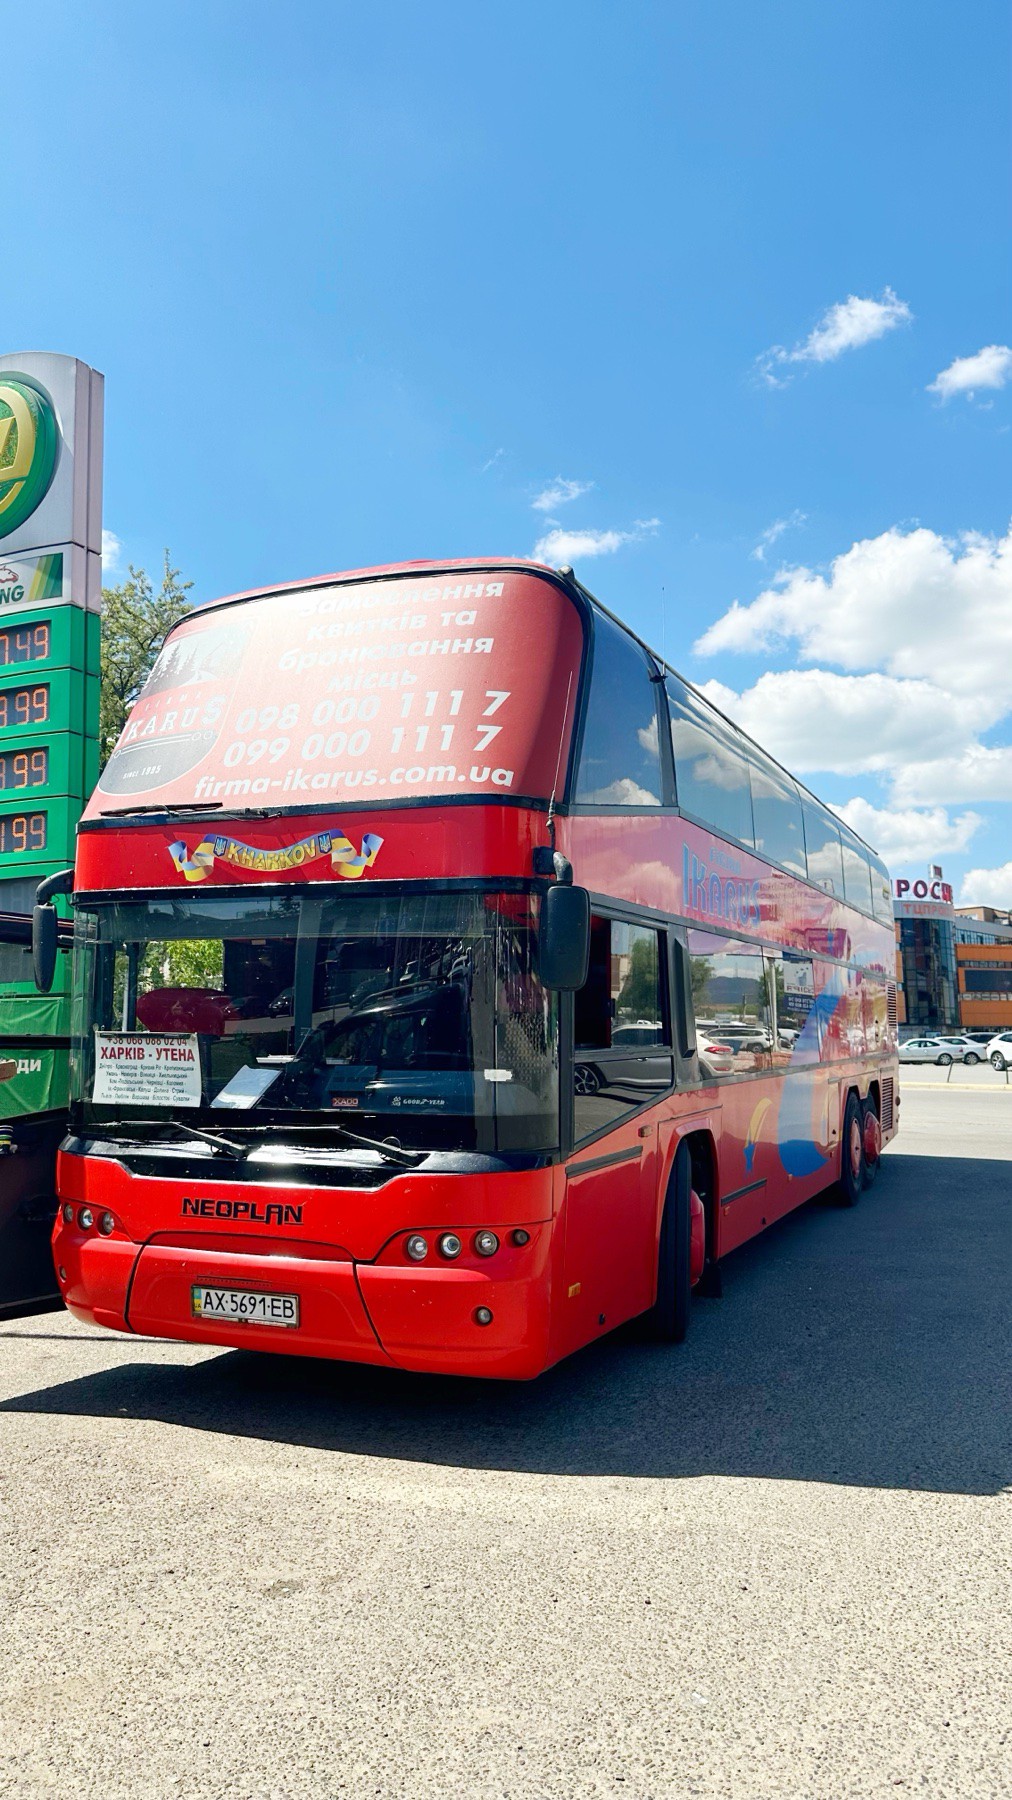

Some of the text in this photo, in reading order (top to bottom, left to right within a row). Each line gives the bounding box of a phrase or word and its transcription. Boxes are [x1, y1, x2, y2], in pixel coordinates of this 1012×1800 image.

[306, 609, 478, 640] квитків та
[278, 637, 494, 673] бронювання
[327, 668, 418, 693] місць
[235, 703, 300, 734] 098
[312, 695, 381, 726] 000
[223, 737, 290, 767] 099
[301, 728, 371, 760] 000
[193, 764, 514, 798] firma-ikarus.com.ua
[228, 840, 316, 870] KHARKOV
[682, 842, 761, 929] IKARUS
[101, 1046, 145, 1060] ХАРКІВ
[155, 1047, 195, 1061] УТЕНА
[182, 1198, 303, 1225] NEOPLAN
